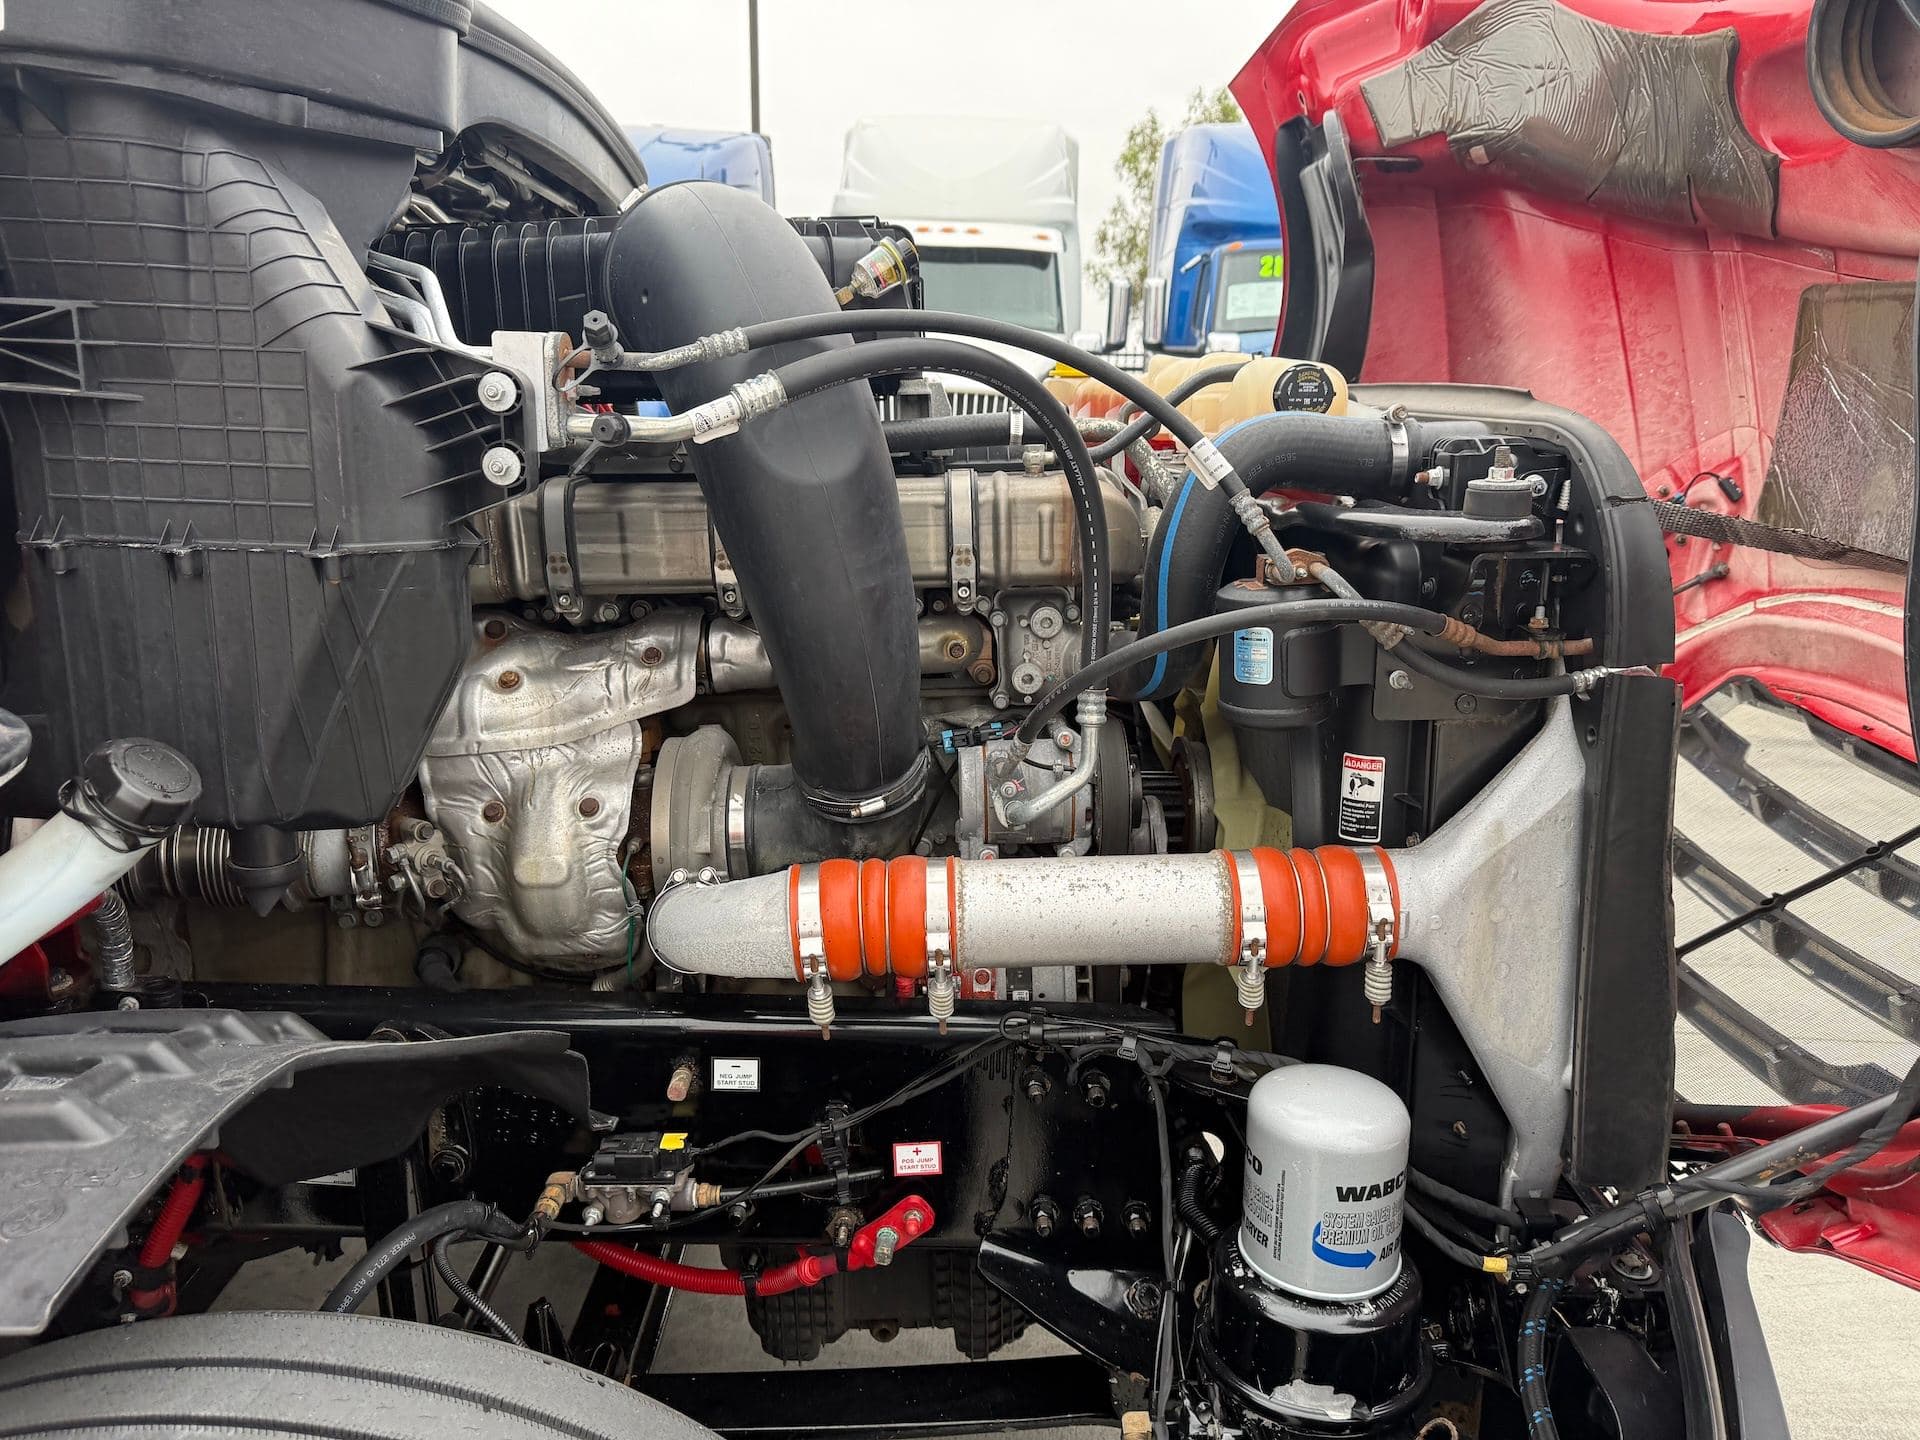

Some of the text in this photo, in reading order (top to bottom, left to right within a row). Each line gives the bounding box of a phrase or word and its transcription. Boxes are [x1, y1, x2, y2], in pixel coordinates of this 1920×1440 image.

[1351, 759, 1382, 771] DANGER
[1322, 1210, 1365, 1230] SYSTEM
[1365, 1205, 1391, 1228] SAVER
[390, 1232, 416, 1255] PARKER
[1321, 1226, 1370, 1246] PREMIUM
[1370, 1225, 1385, 1242] OIL
[1378, 1241, 1394, 1262] AIR
[351, 1278, 366, 1295] AIR
